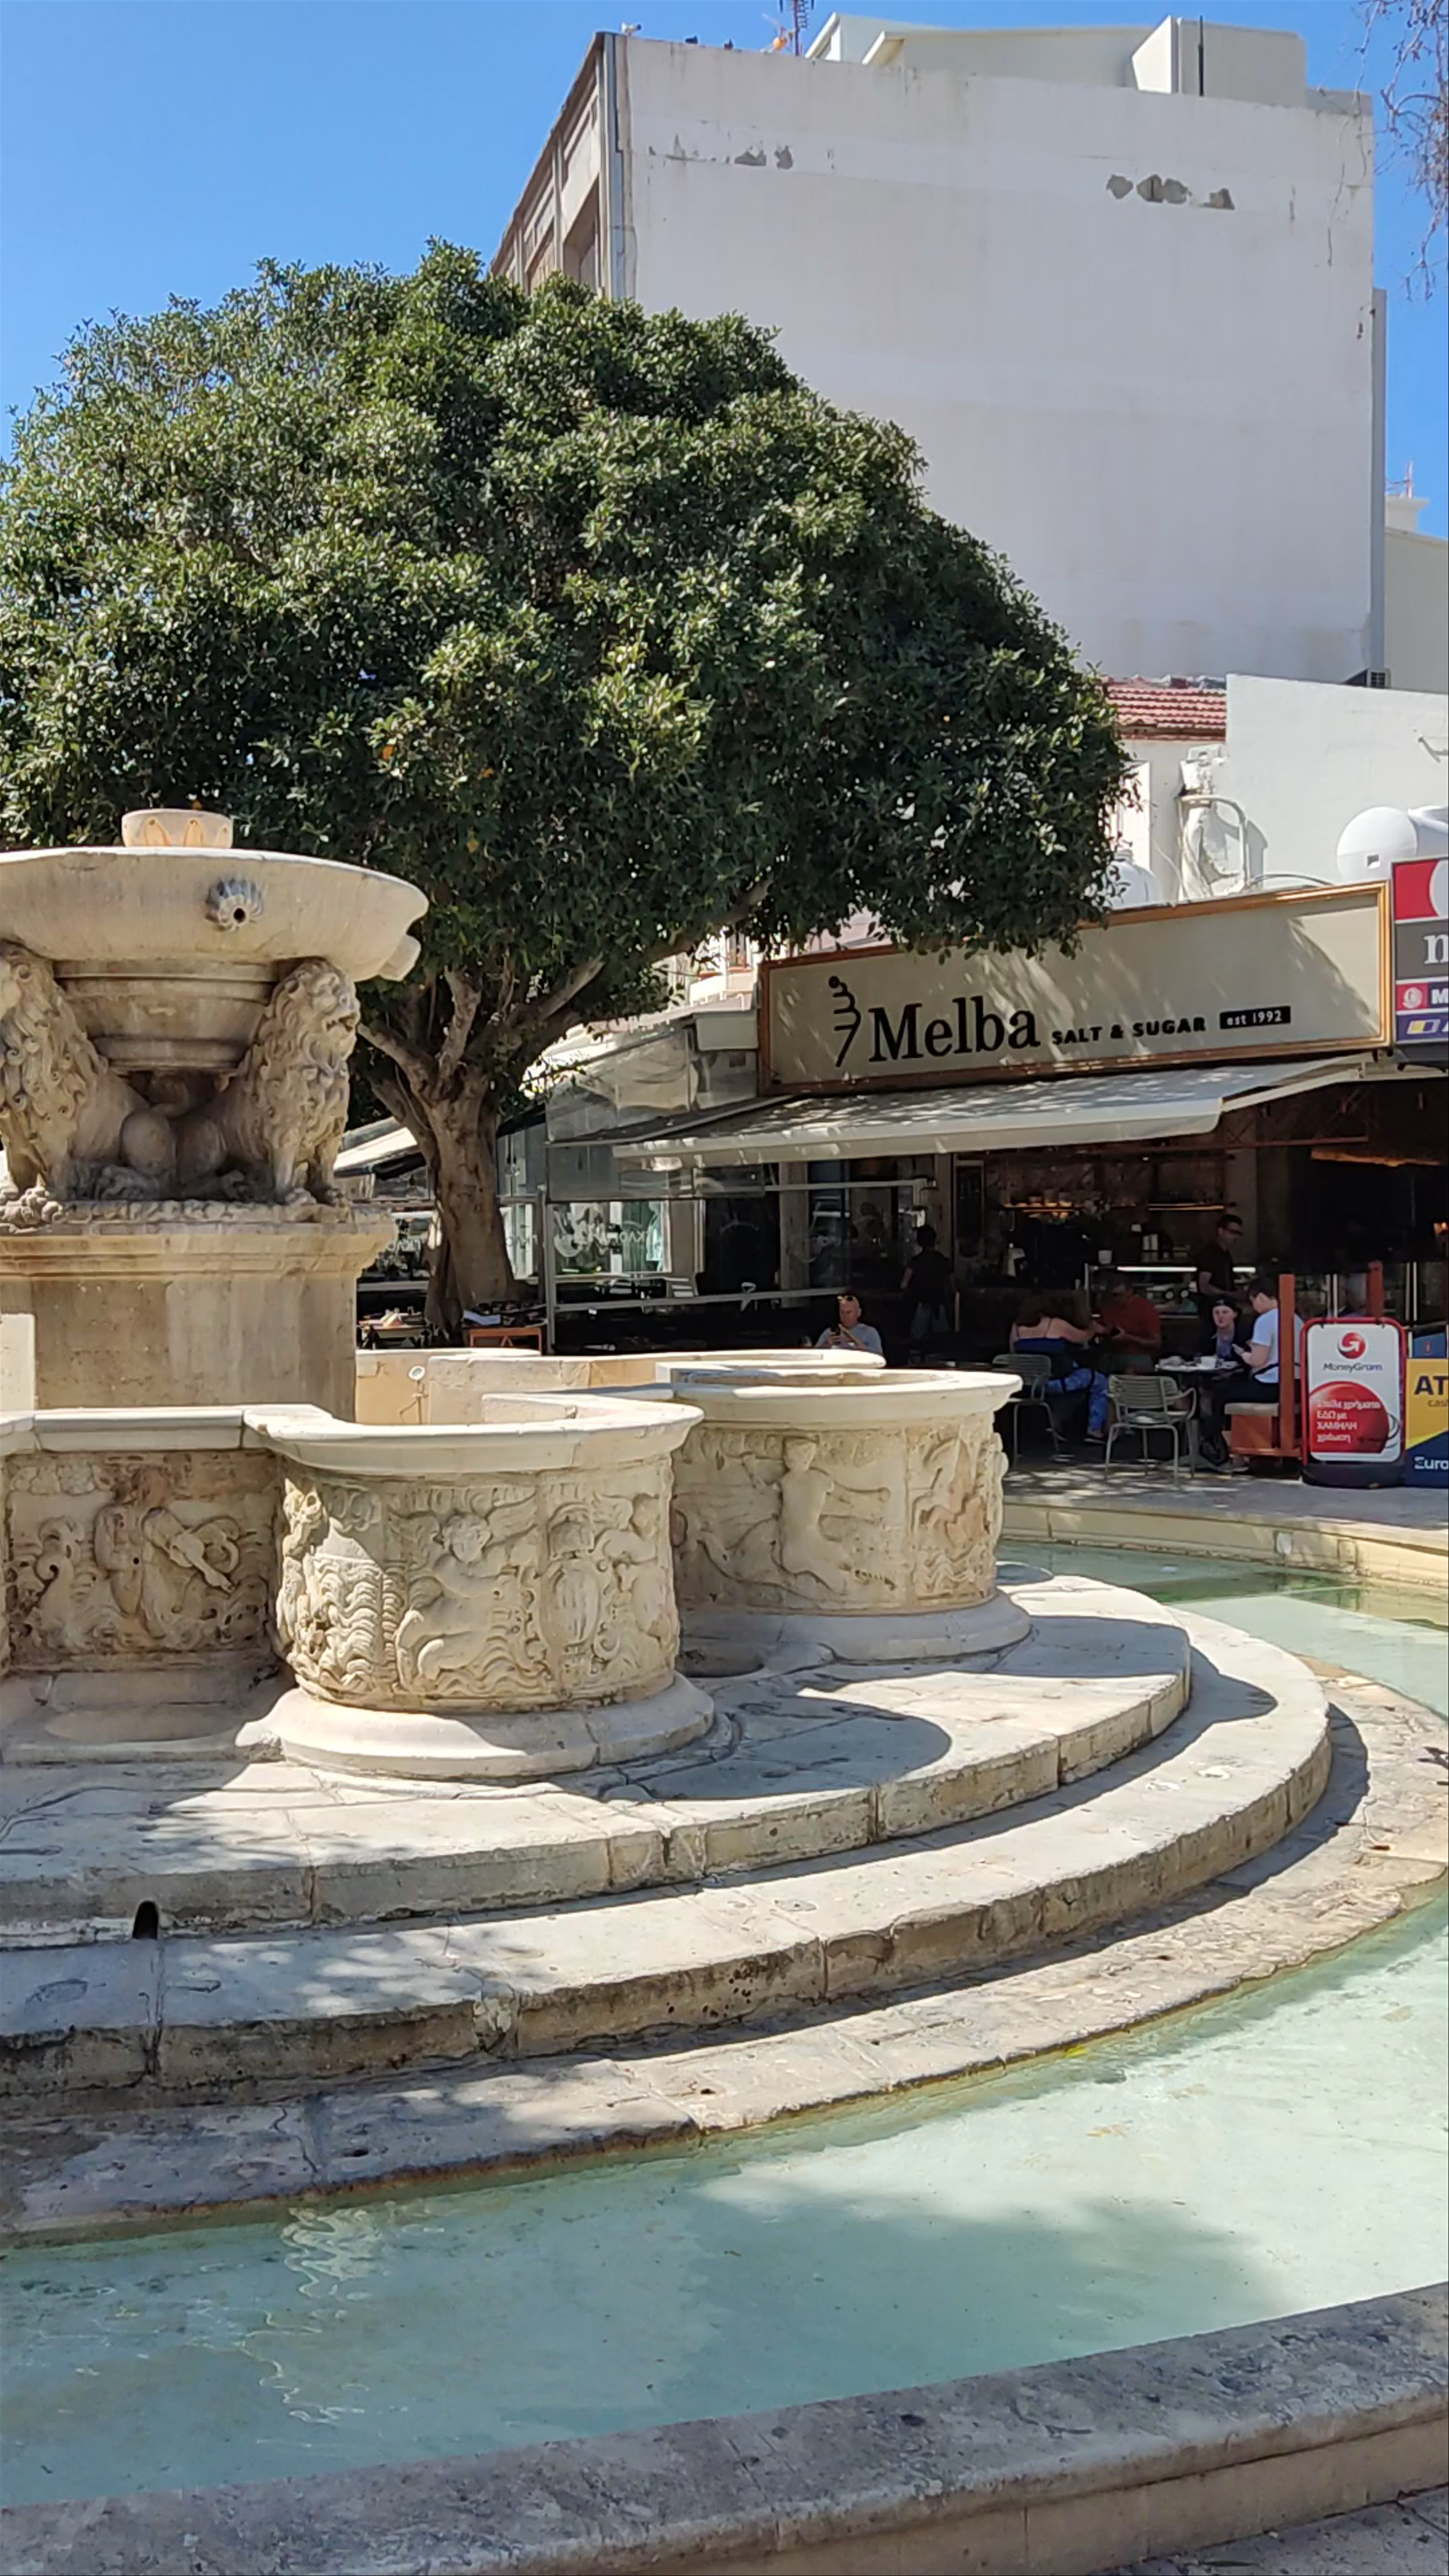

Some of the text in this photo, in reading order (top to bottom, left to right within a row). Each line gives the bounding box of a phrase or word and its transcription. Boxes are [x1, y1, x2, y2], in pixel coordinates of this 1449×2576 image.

[868, 995, 1283, 1062] Melba SALT & SUGAR est 1992
[1323, 1363, 1383, 1373] MoneyGram
